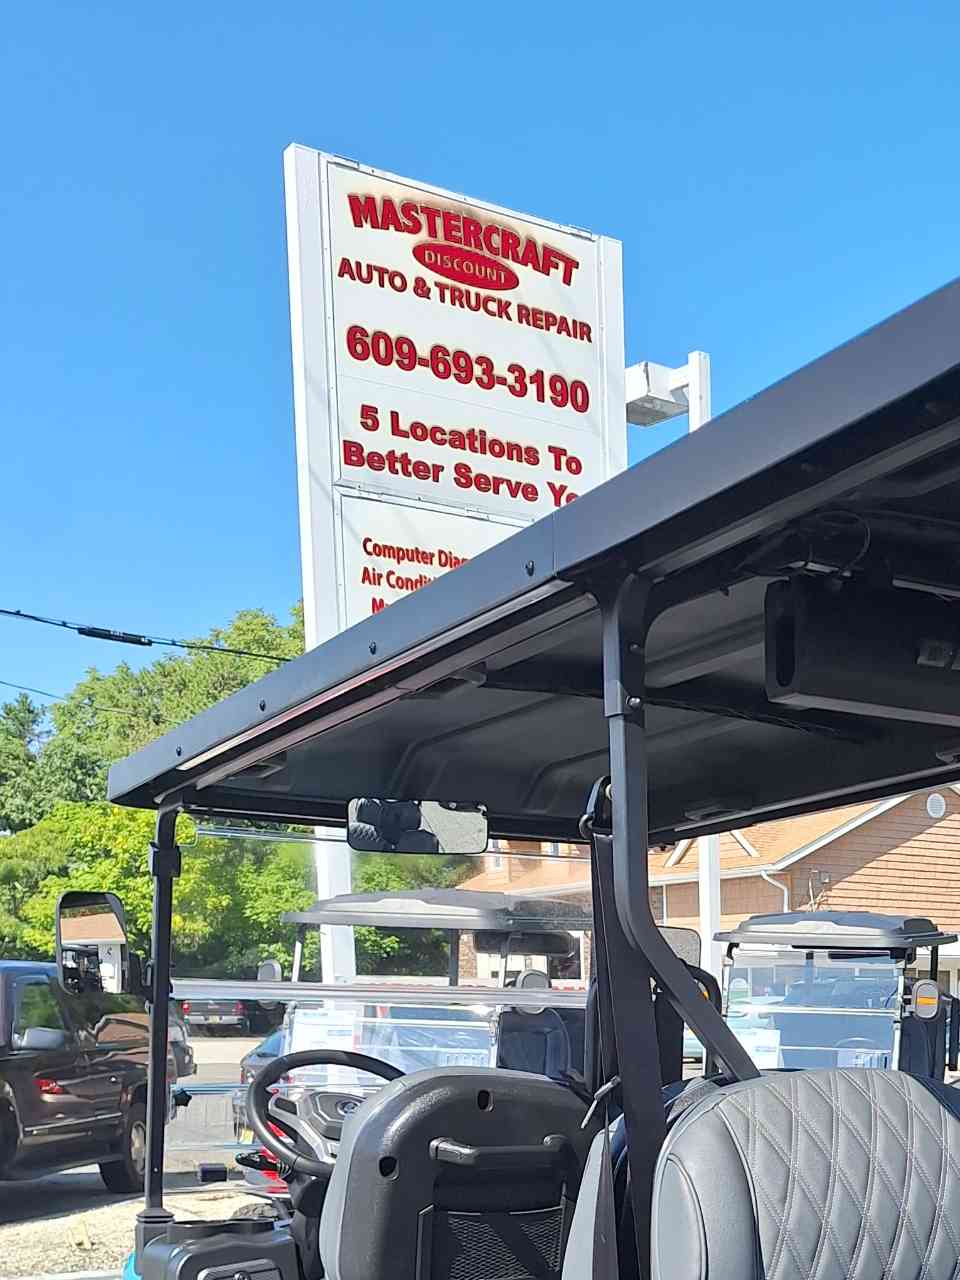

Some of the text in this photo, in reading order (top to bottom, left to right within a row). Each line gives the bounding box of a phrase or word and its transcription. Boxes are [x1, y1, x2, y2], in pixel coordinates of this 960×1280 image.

[347, 194, 579, 286] MASTERCRAFT
[424, 250, 506, 284] DISCOUNT
[338, 257, 592, 343] AUTO & TRUCK REPAIR
[346, 325, 590, 413] 609-693-3190
[342, 440, 444, 483] Better
[454, 463, 539, 502] Serve
[360, 404, 582, 475] 5 Locations To
[361, 567, 383, 586] Air
[362, 537, 435, 565] Computer
